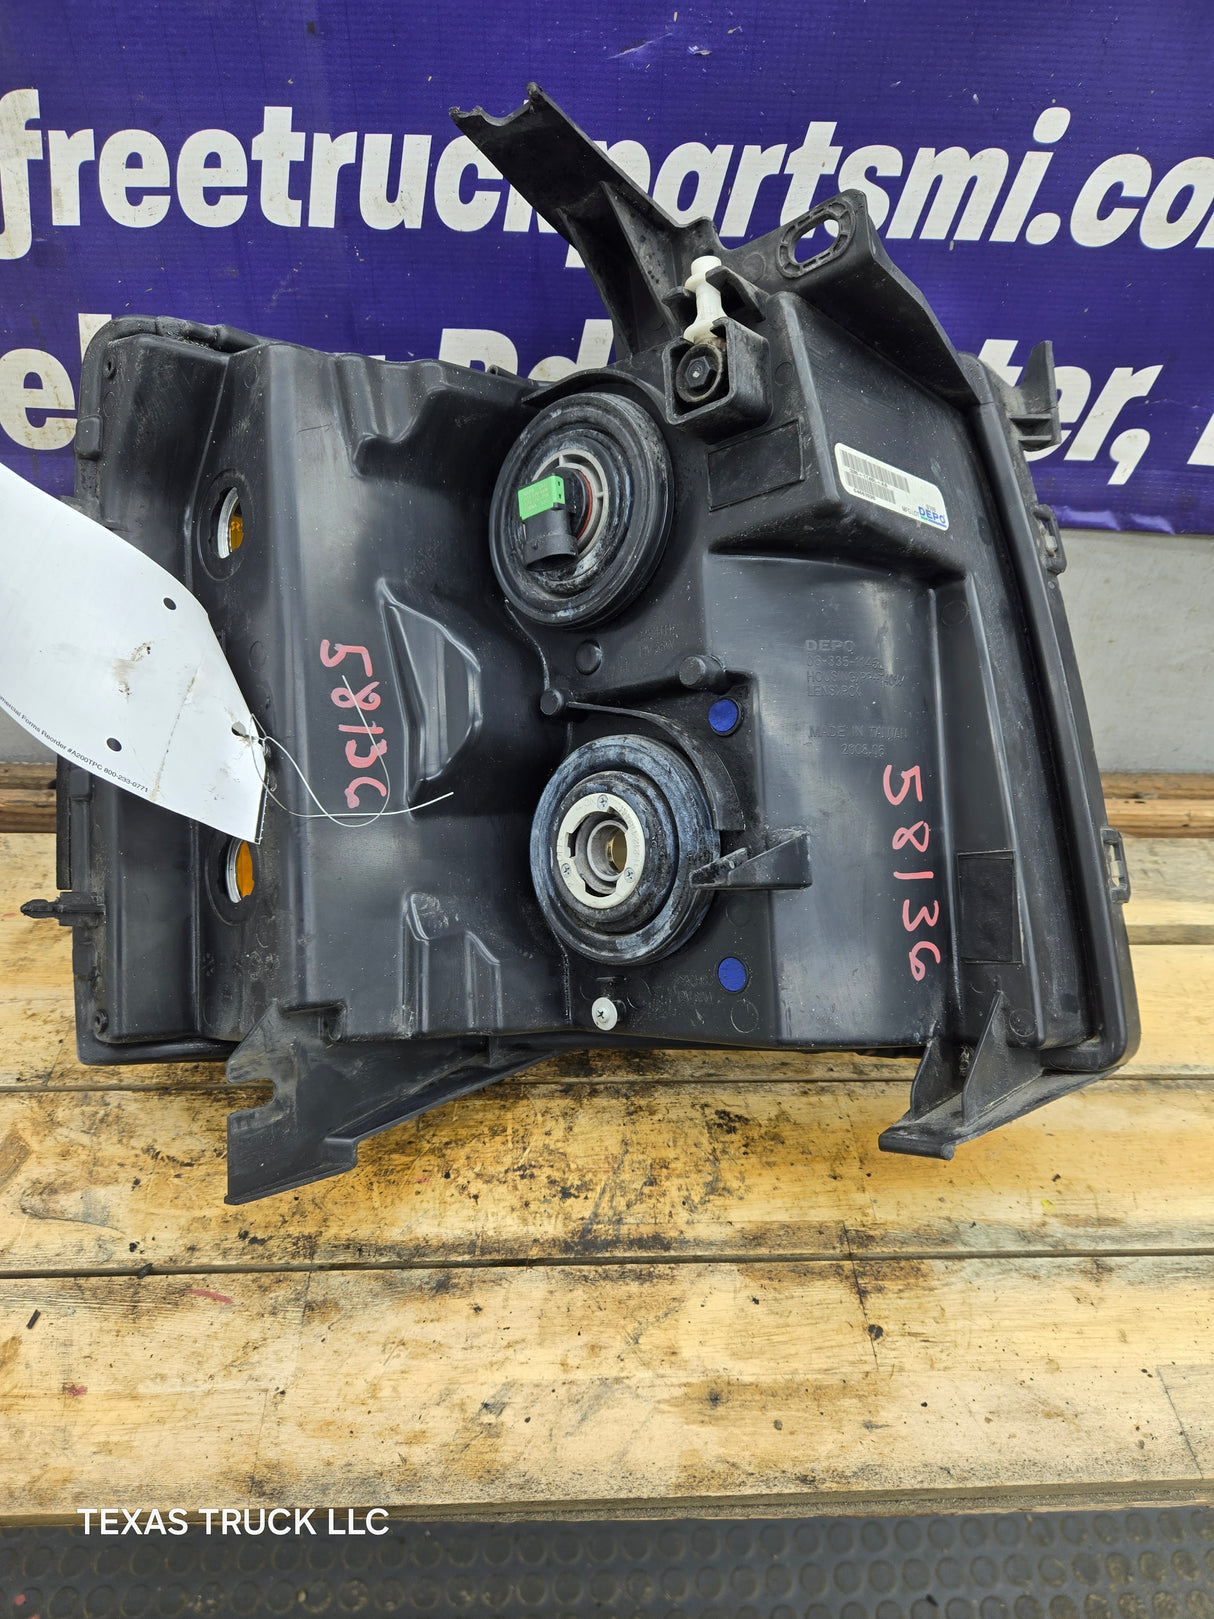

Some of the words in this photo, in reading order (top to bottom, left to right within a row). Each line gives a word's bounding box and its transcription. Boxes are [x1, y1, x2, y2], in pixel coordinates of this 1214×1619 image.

[0, 88, 1214, 268] freetrucartsmi.co
[918, 506, 946, 524] DEPO
[804, 639, 856, 653] DEPO
[21, 714, 40, 732] Forms
[41, 729, 67, 750] Reorder
[67, 747, 103, 770] #A200TPC
[103, 768, 149, 793] 800-233-0771
[883, 764, 941, 982] 58136
